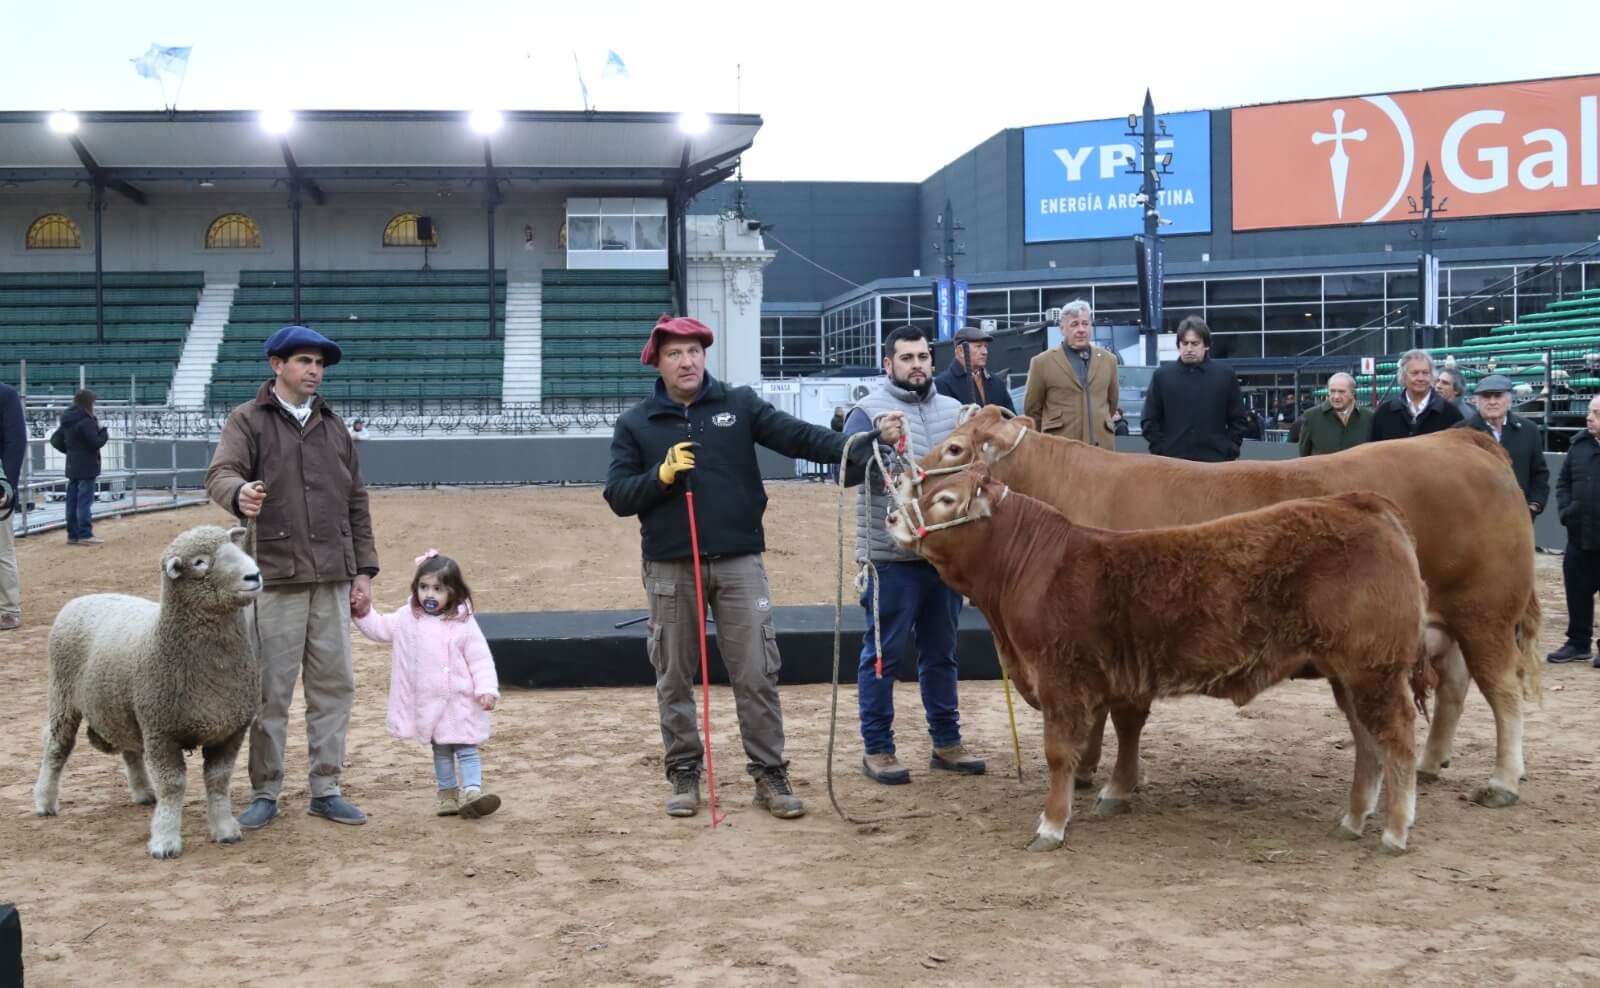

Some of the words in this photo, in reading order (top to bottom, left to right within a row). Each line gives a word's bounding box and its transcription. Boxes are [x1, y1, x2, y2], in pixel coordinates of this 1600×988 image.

[1441, 95, 1598, 194] Gal
[1040, 193, 1103, 214] ENERGÍA
[1107, 189, 1194, 210] ARGTINA
